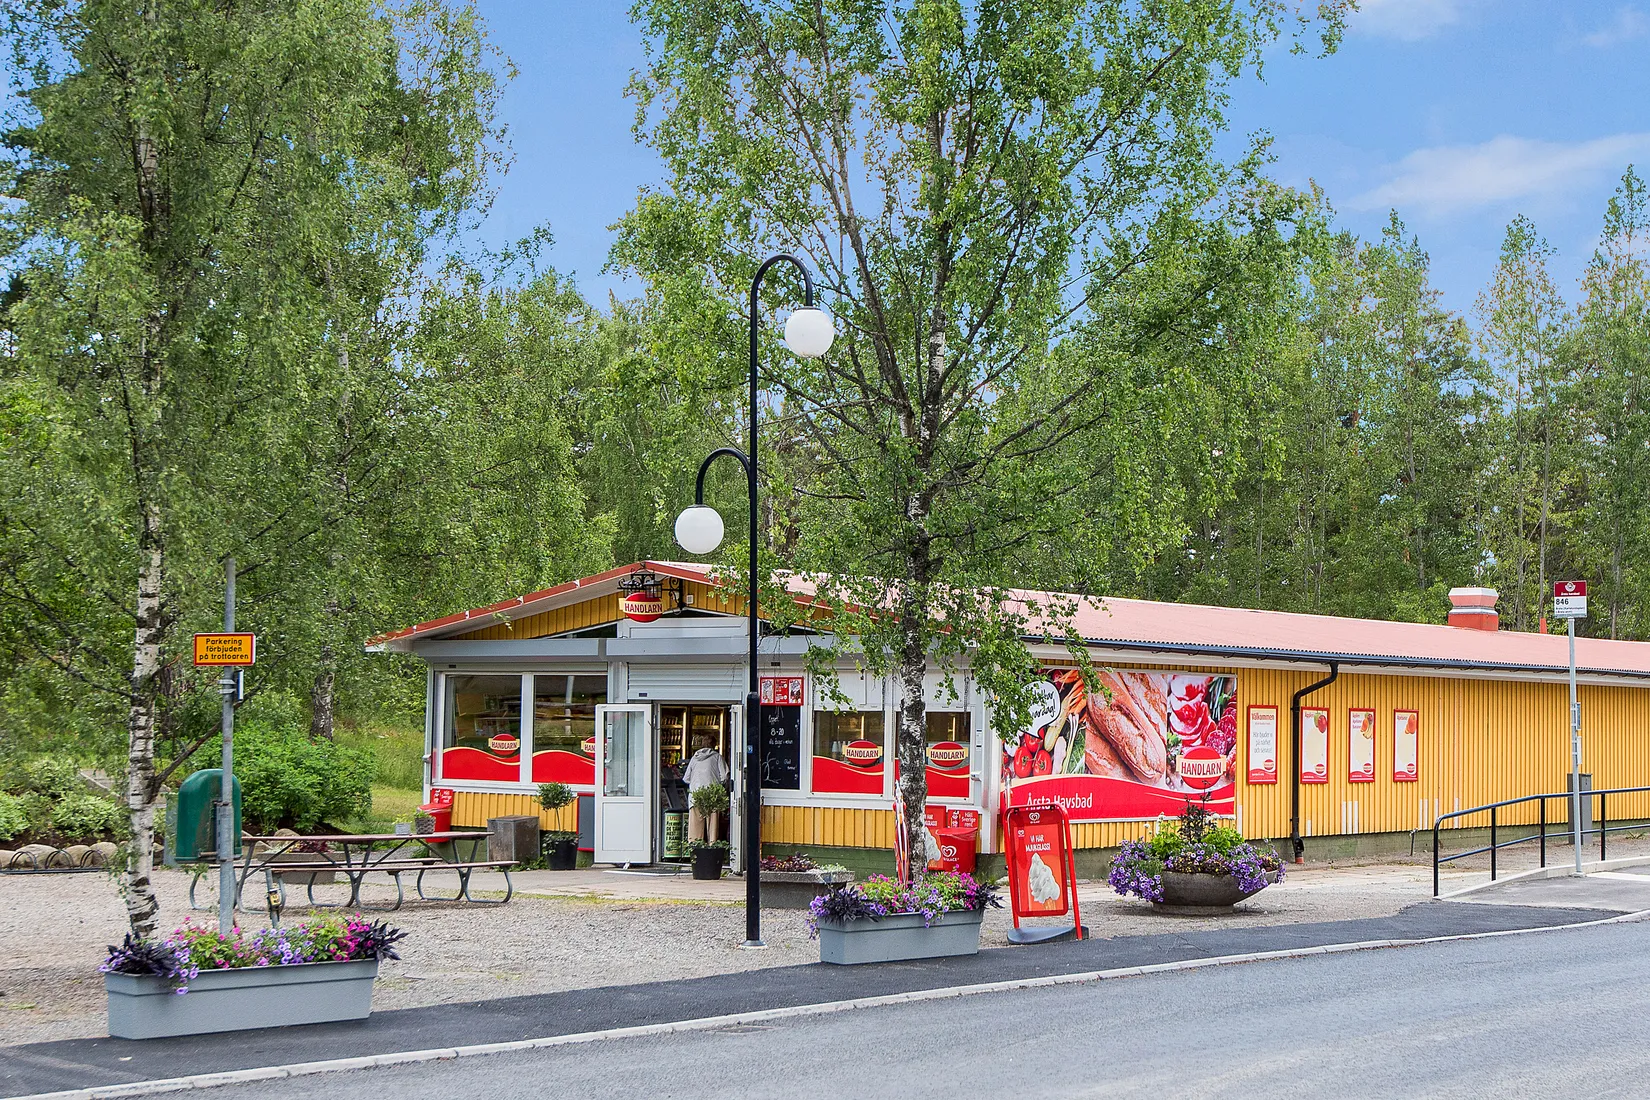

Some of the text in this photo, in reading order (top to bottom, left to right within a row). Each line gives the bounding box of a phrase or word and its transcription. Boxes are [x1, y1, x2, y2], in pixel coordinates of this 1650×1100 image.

[624, 603, 663, 613] HANDLARN
[205, 638, 243, 646] Parkering
[199, 653, 209, 661] på
[1251, 712, 1275, 720] Välkommen
[491, 741, 518, 750] HANDLARN
[846, 749, 879, 758] HANDLARN
[930, 750, 965, 759] HANDLARN
[1181, 761, 1222, 775] HANDLARN
[1053, 792, 1093, 810] Havsbad
